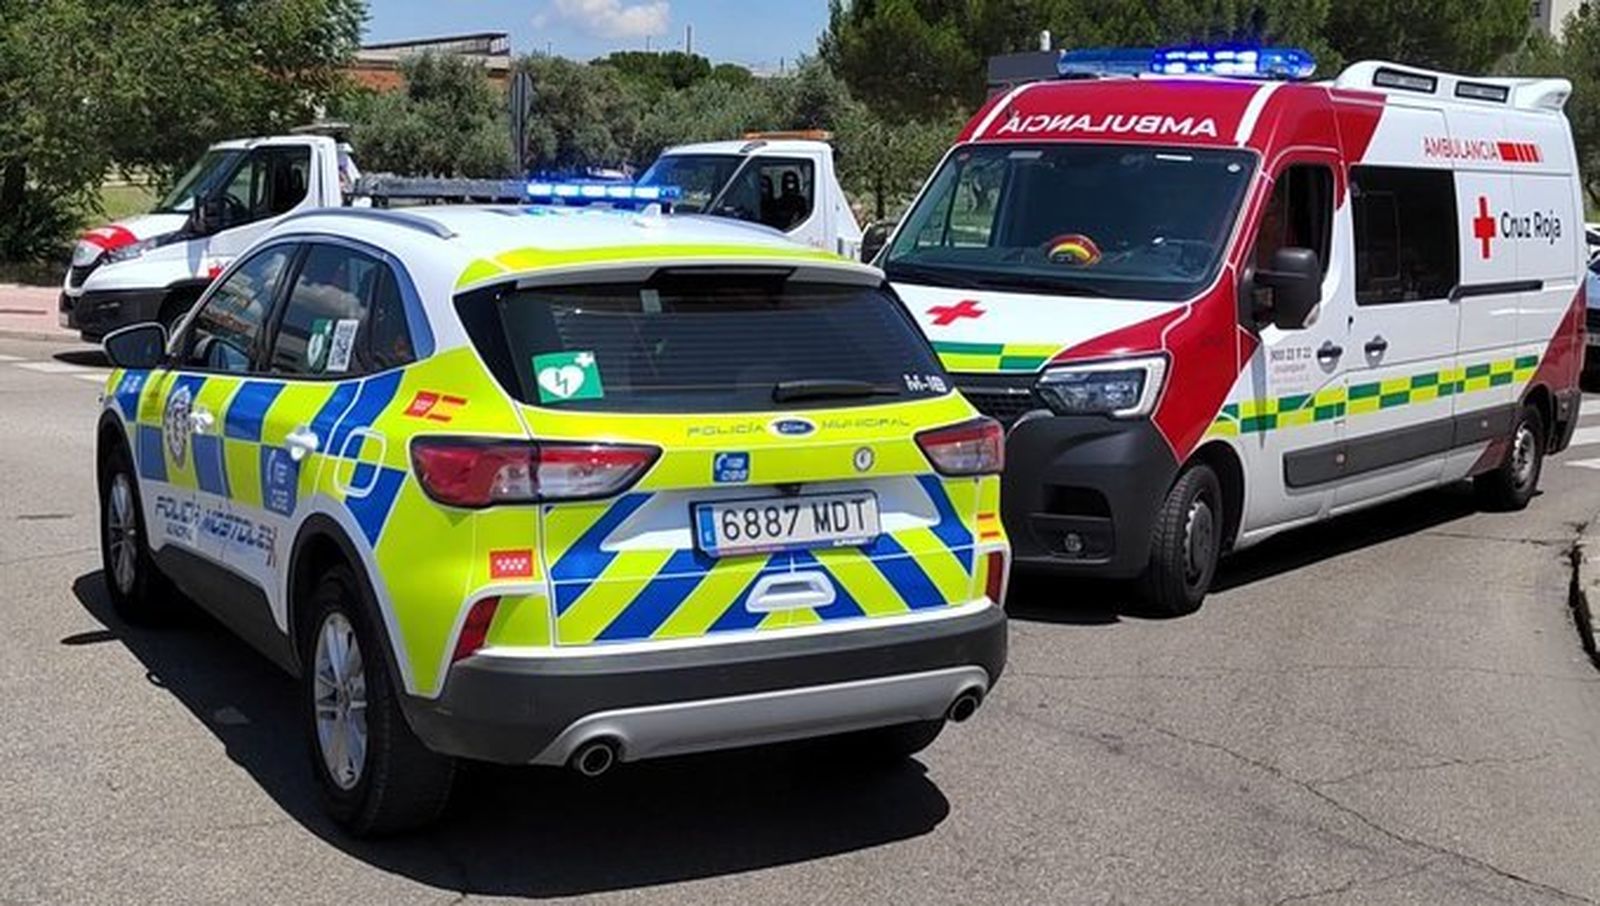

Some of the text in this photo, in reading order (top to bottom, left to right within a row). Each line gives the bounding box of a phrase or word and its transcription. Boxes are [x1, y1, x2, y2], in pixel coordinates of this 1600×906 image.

[1500, 210, 1562, 245] Cruz Roja
[721, 499, 867, 541] 6887 MDT
